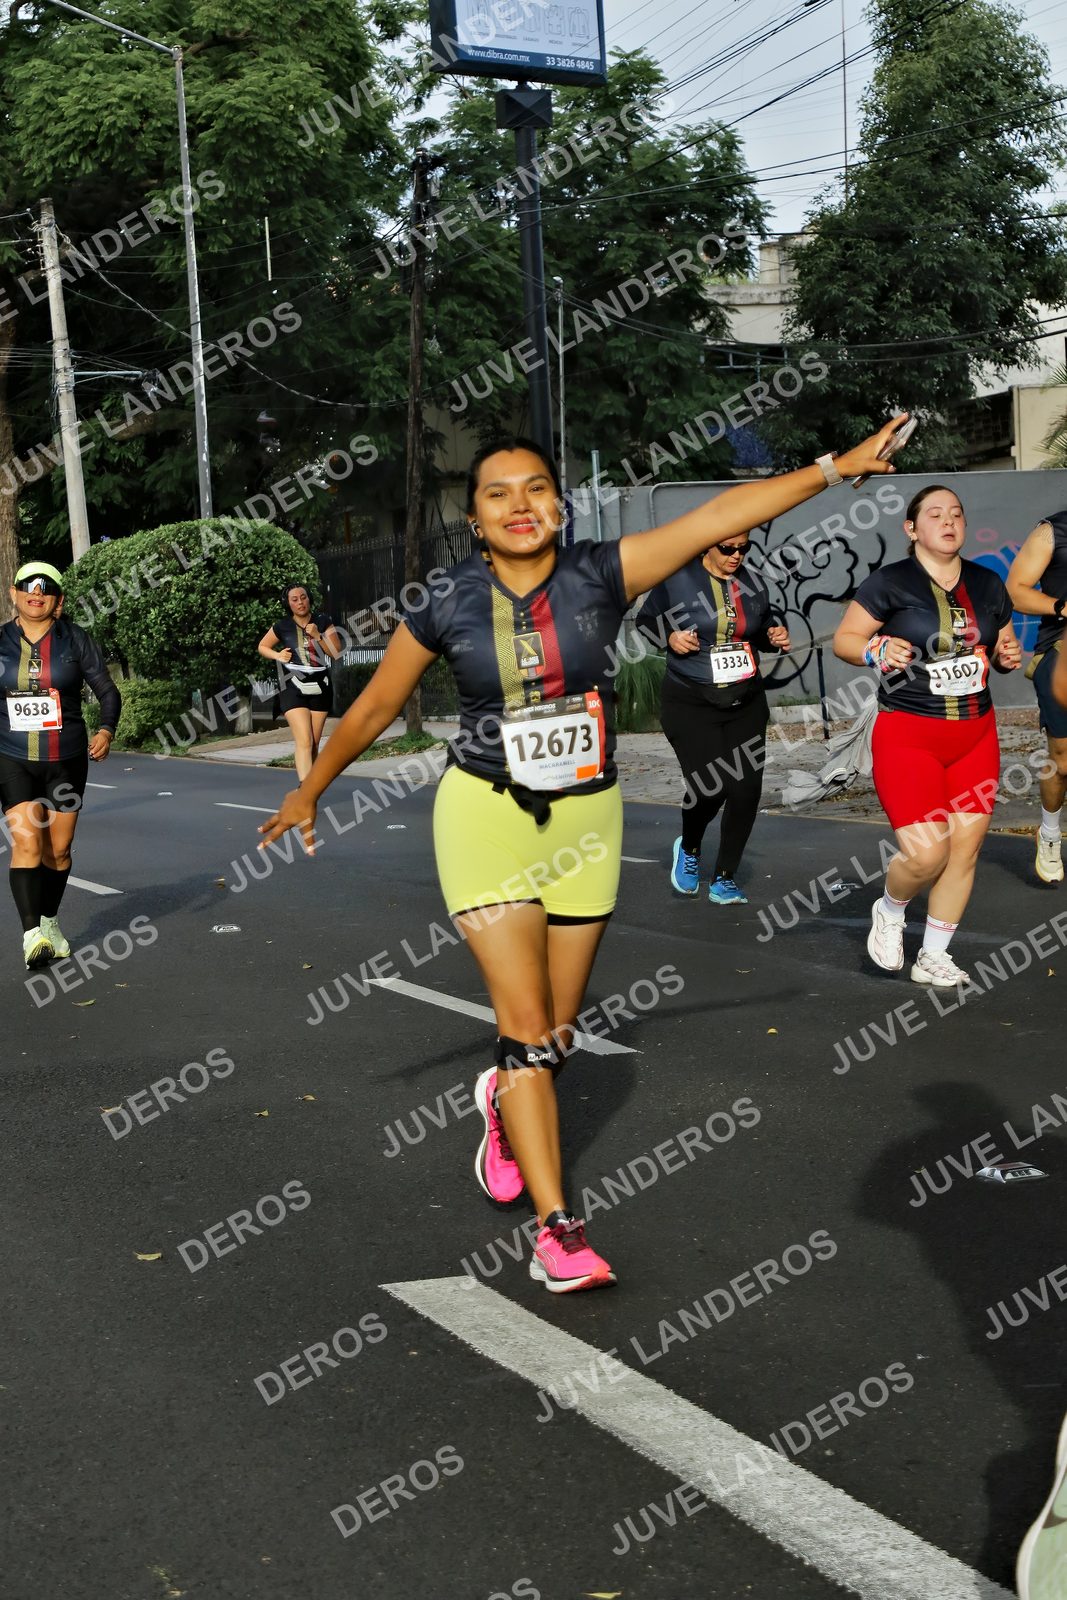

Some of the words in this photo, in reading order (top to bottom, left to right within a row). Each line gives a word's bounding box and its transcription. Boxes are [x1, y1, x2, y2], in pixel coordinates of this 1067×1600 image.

[467, 47, 531, 63] www.dibra.com.mx
[546, 56, 556, 66] 33
[557, 57, 576, 69] 3826
[576, 60, 595, 71] 4845
[714, 655, 749, 670] 13334
[932, 661, 979, 681] 11607
[14, 702, 50, 716] 9638
[510, 723, 593, 763] 12673
